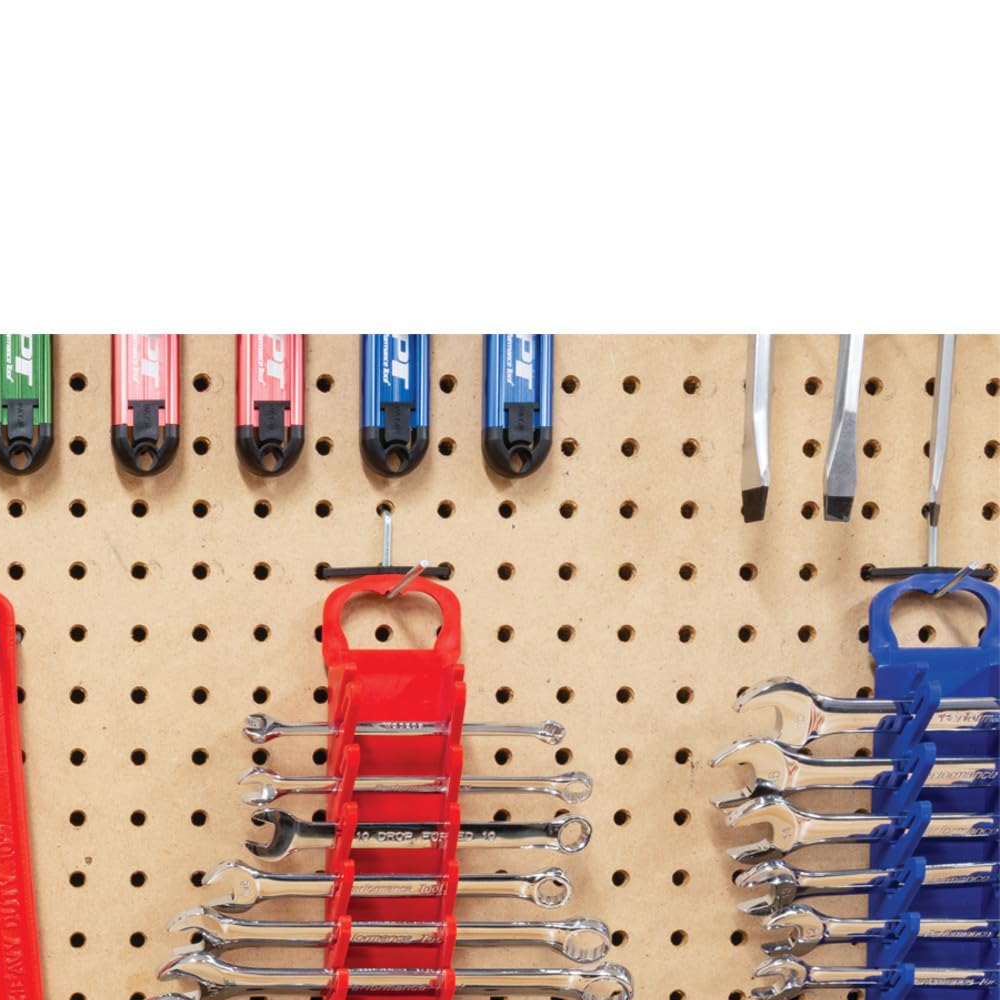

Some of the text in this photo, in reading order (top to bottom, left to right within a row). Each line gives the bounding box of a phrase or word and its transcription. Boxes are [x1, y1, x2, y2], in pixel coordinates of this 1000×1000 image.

[391, 334, 409, 390] PT
[515, 334, 533, 390] PT
[377, 831, 413, 841] DROP
[421, 831, 473, 841] FORED
